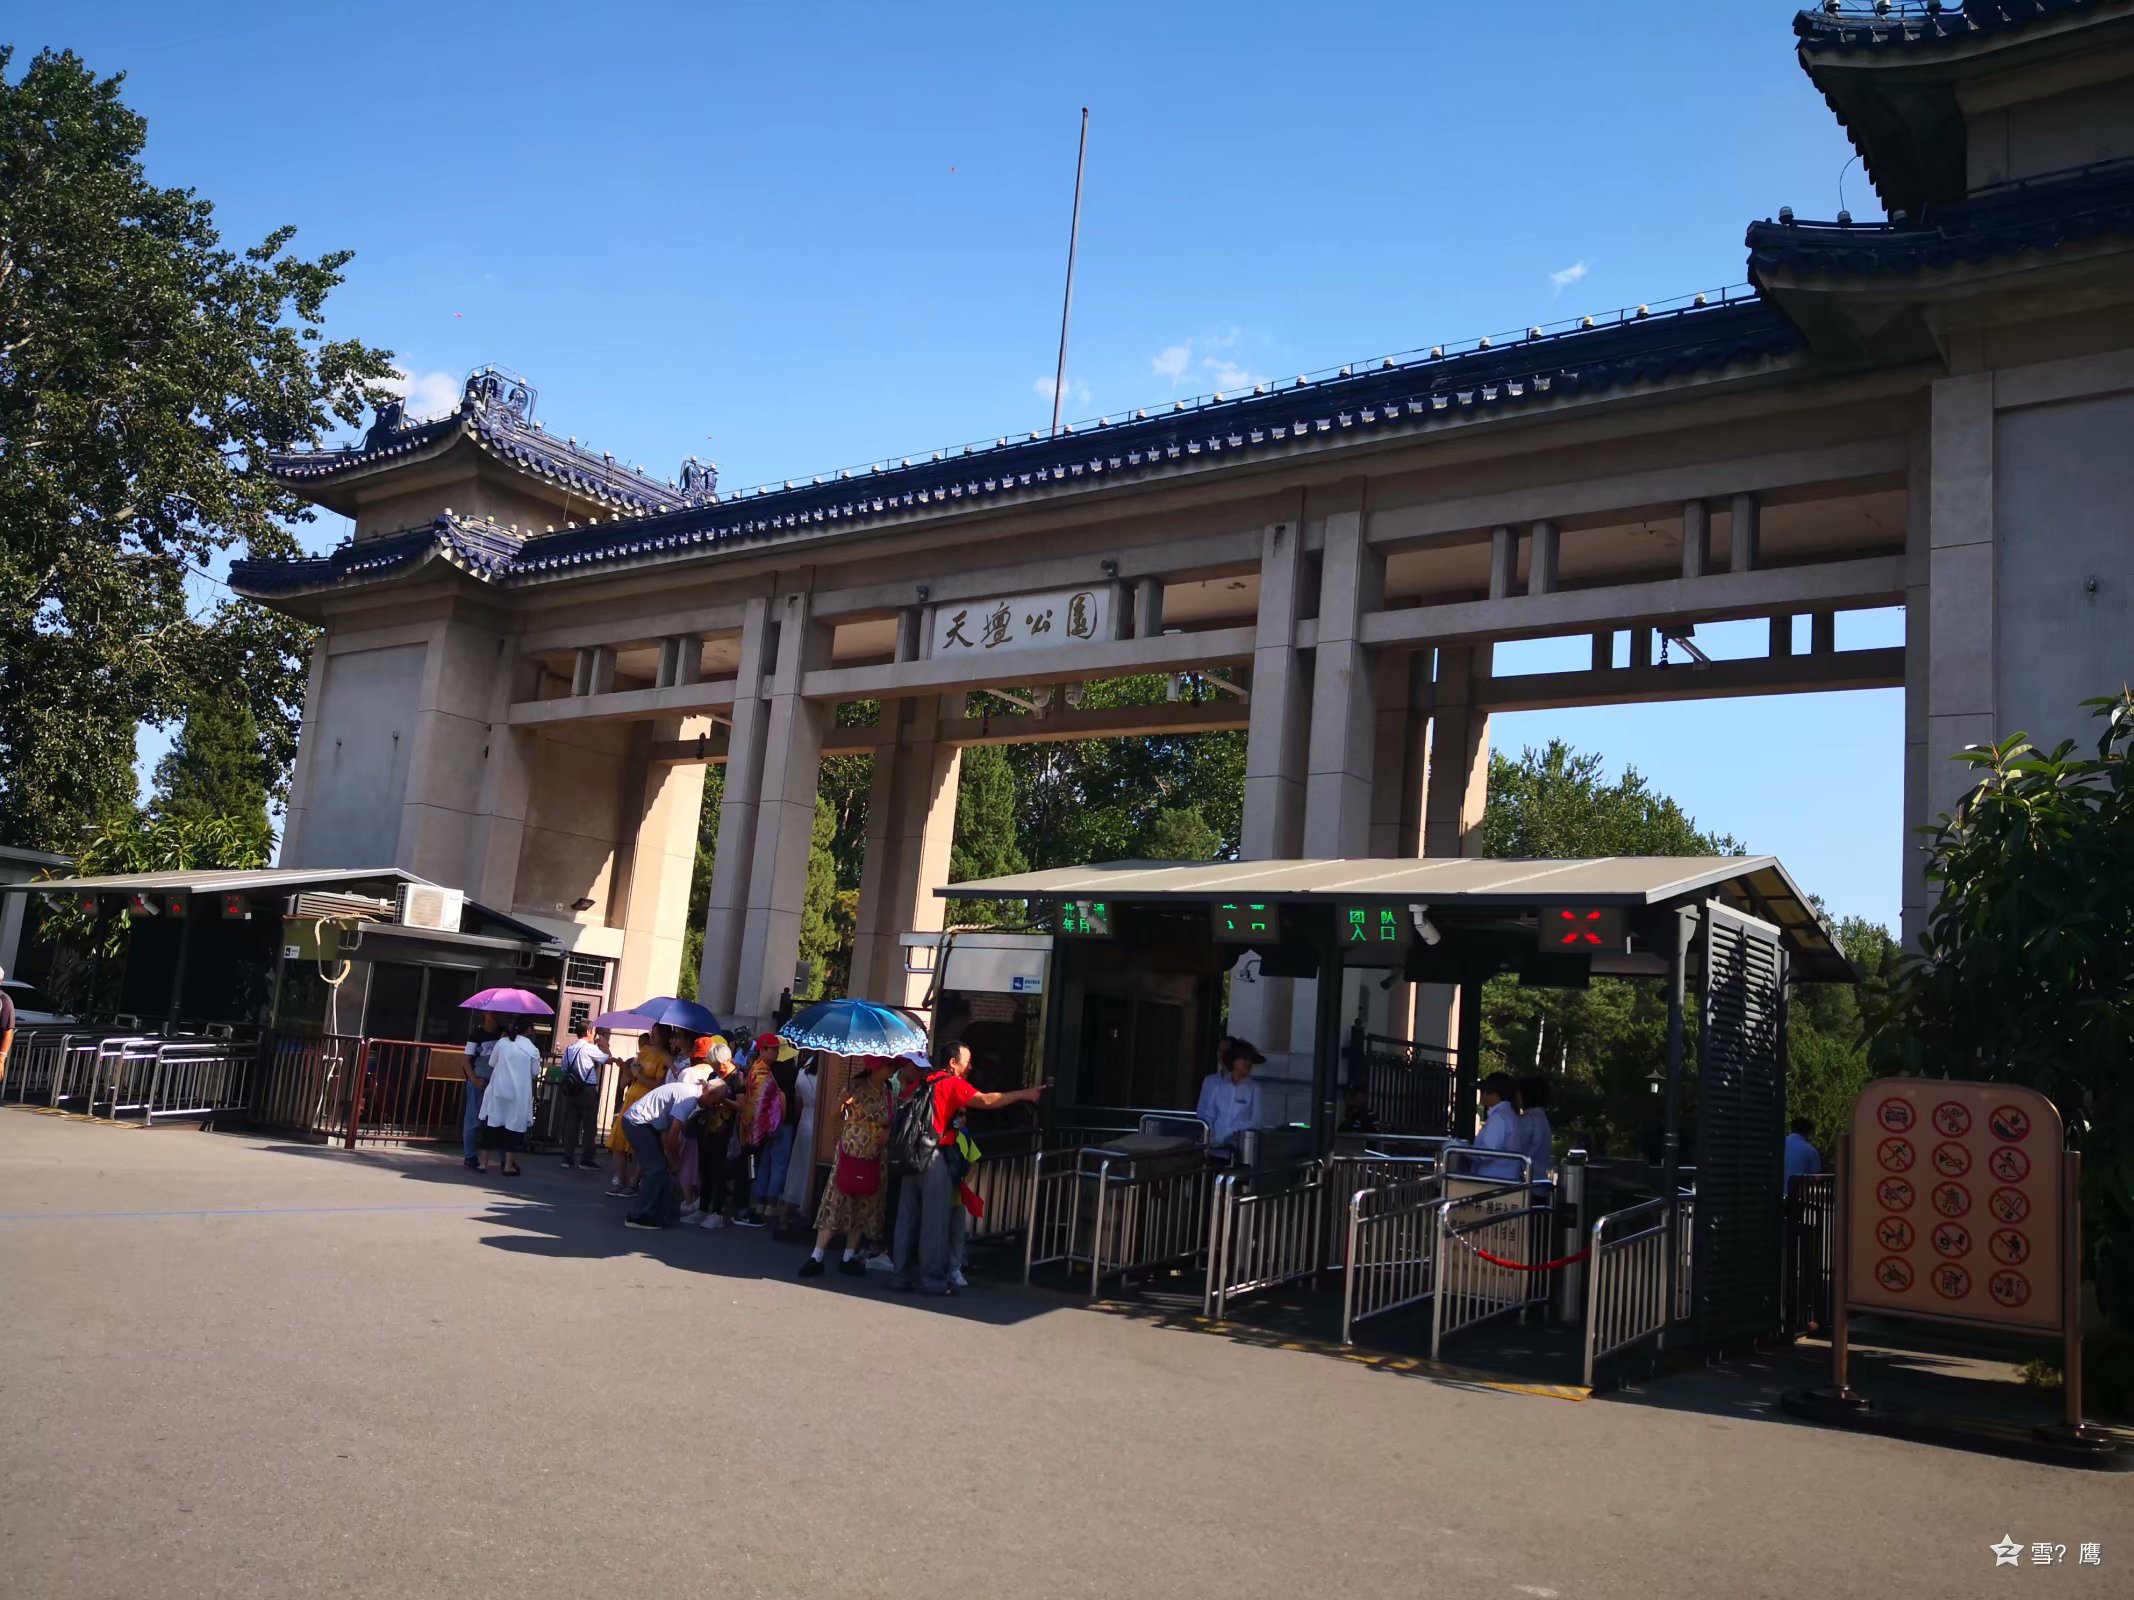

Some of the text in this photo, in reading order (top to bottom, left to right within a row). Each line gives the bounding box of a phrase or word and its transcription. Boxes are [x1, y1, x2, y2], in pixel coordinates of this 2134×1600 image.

[1062, 902, 1107, 918] 北通
[1062, 918, 1108, 934] 年月
[1350, 924, 1395, 941] 入口
